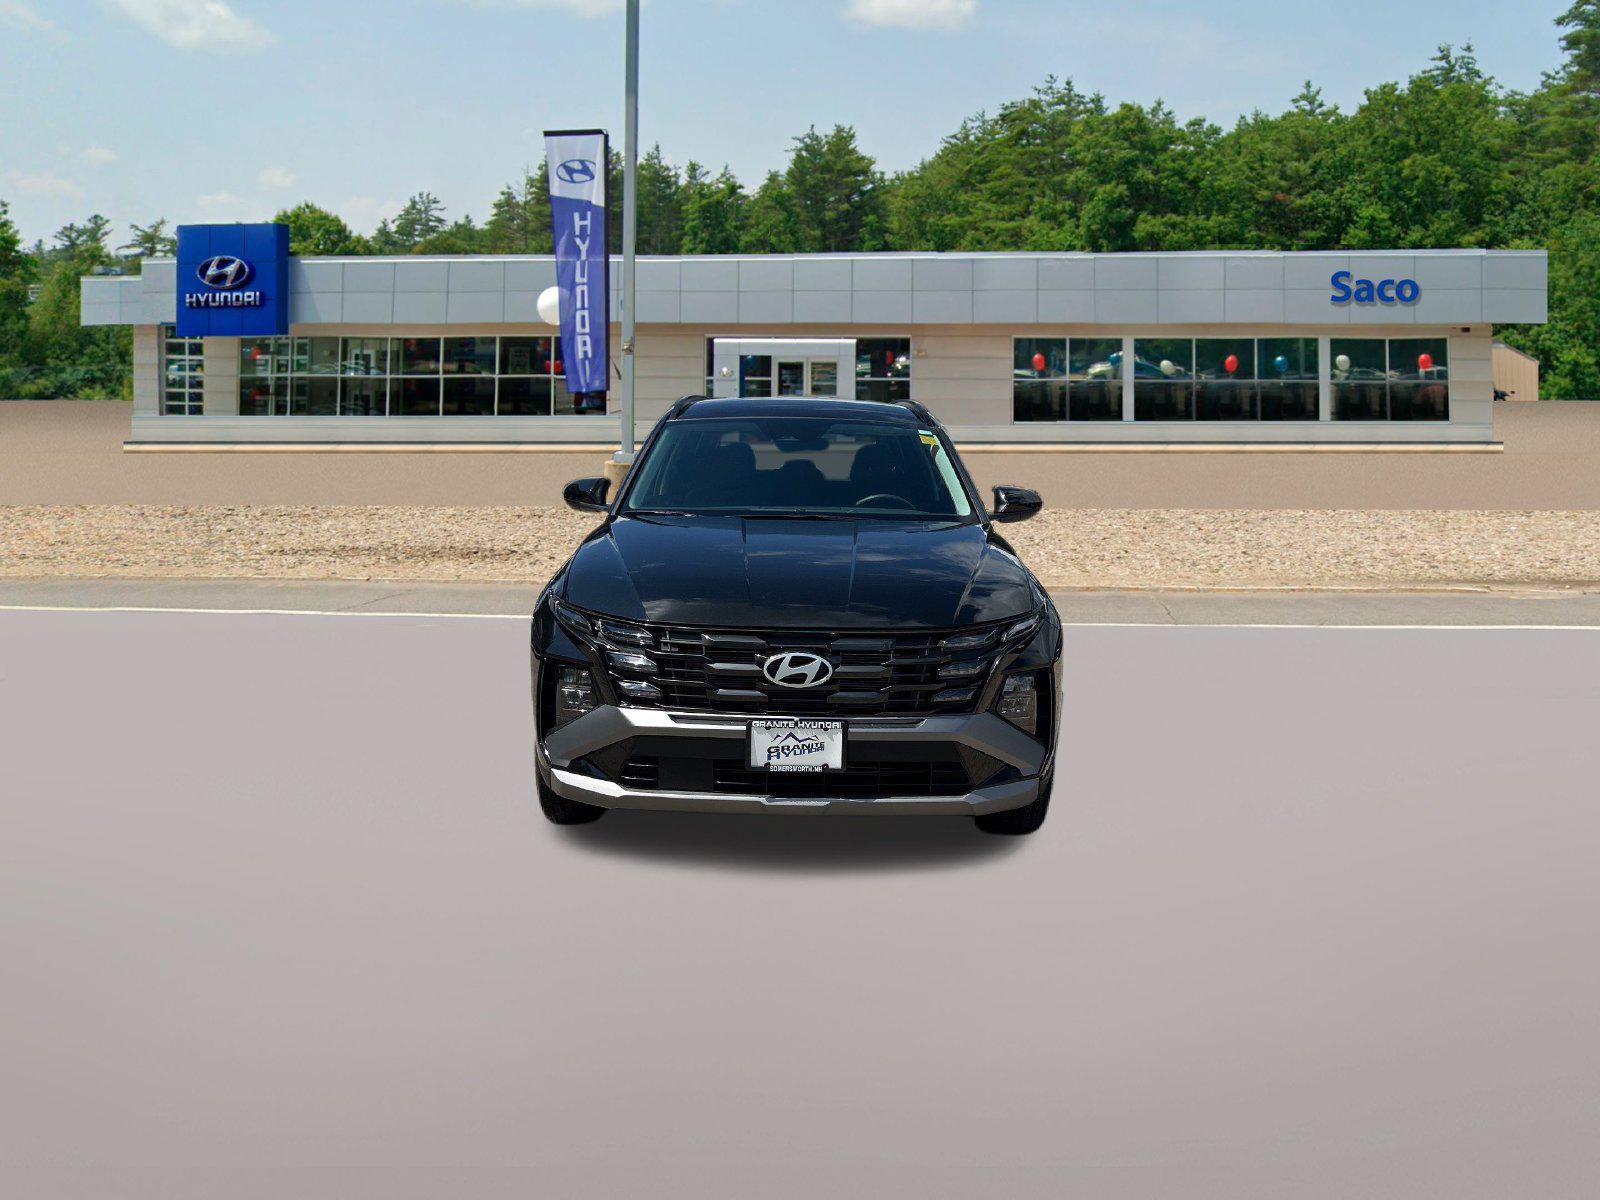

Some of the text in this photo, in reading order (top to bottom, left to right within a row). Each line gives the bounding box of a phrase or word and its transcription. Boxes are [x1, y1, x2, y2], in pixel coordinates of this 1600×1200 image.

[1330, 270, 1420, 303] Saco
[185, 292, 261, 307] HYUNDAI
[573, 211, 593, 383] HYUNDAI
[752, 720, 842, 729] GRANITE HYUNDAI
[766, 747, 825, 761] HYUNDAI
[767, 741, 825, 755] GRANITE
